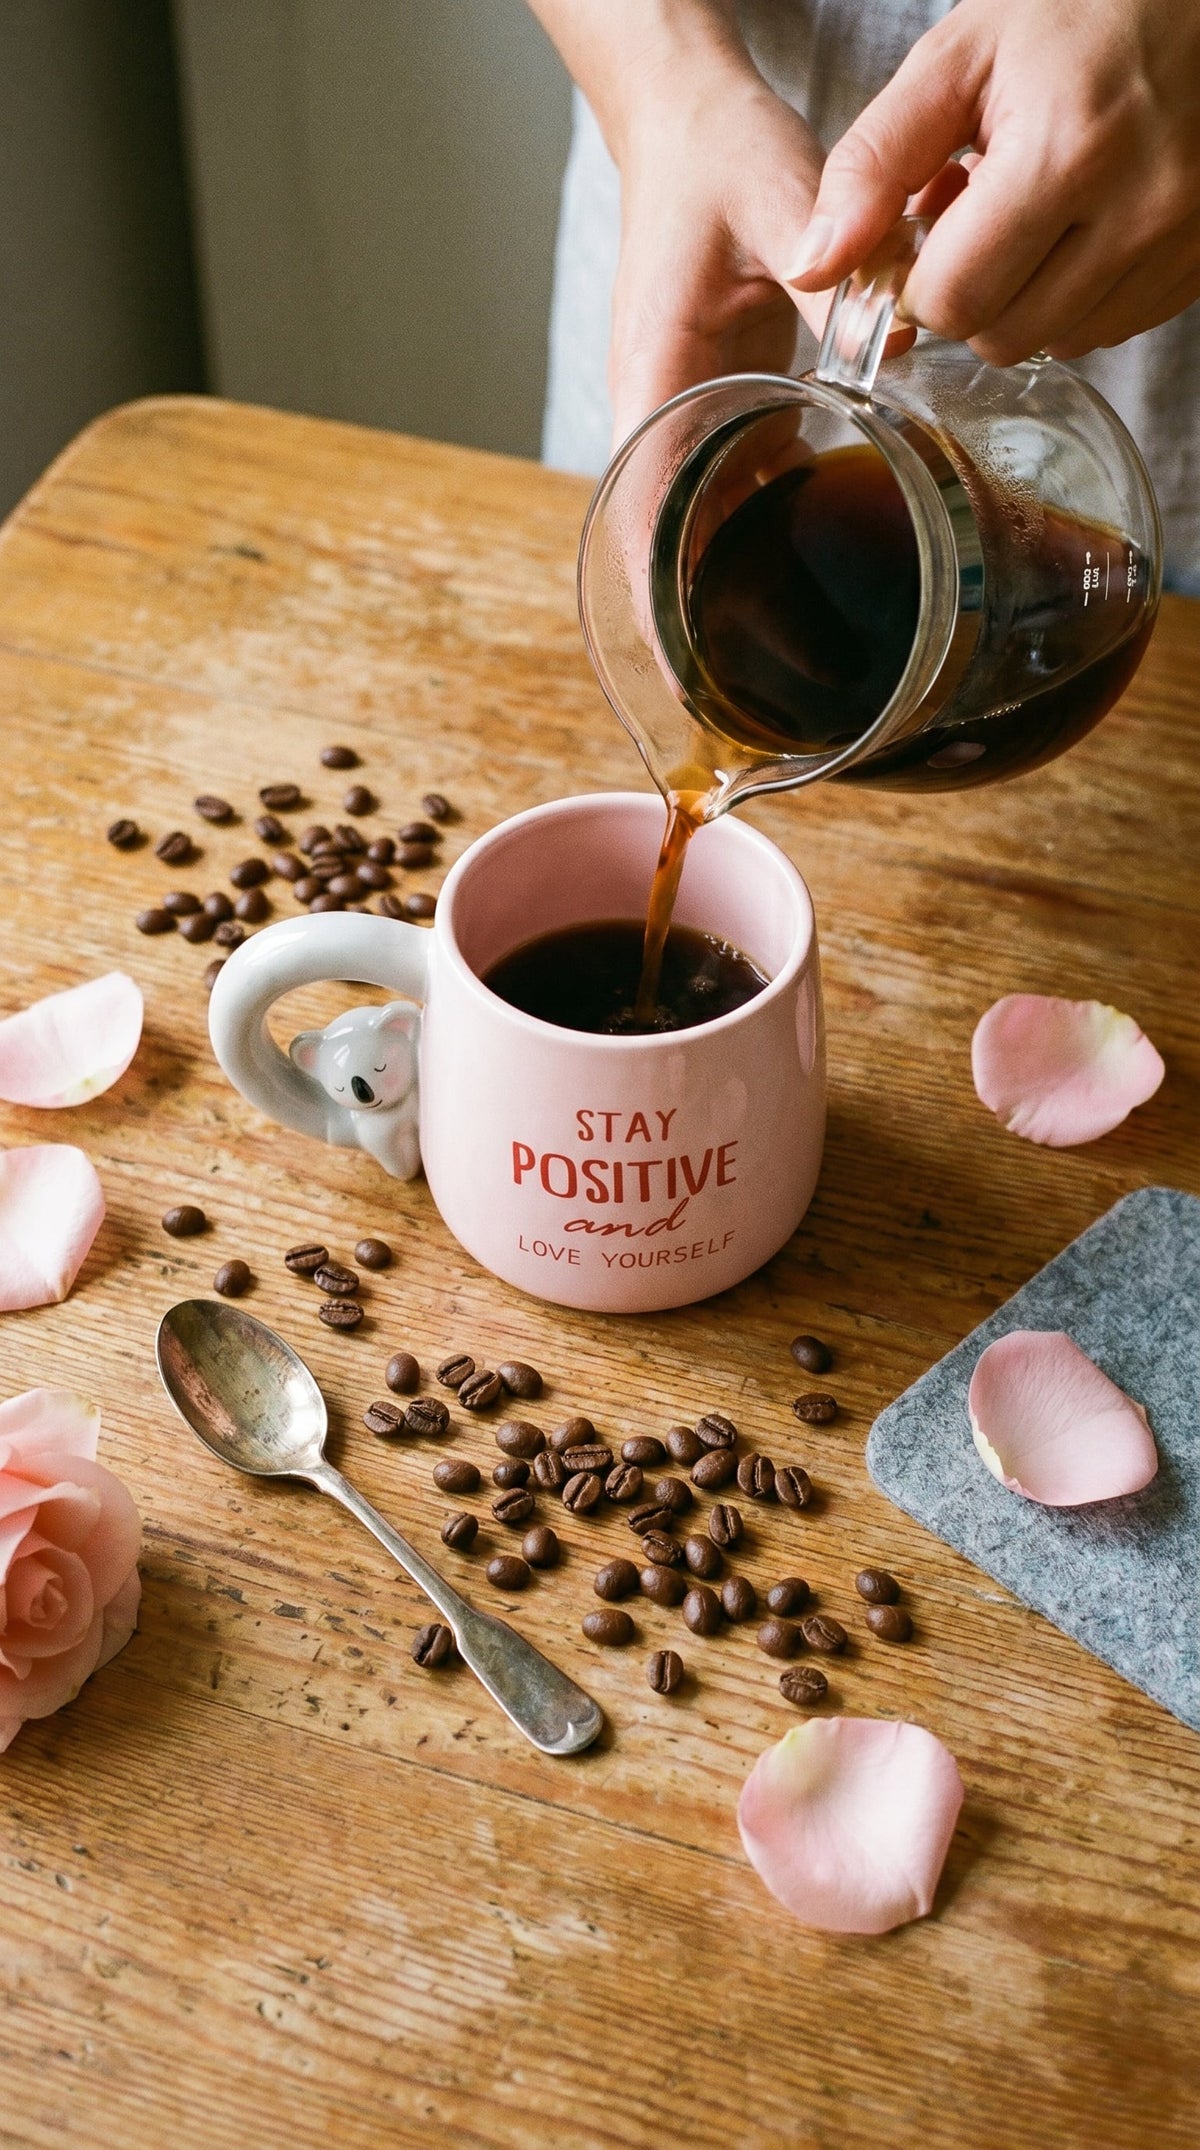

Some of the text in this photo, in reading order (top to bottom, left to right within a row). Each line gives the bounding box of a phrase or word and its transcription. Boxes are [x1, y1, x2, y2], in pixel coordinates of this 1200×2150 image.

[576, 1108, 677, 1143] STAY
[512, 1140, 738, 1204] POSITIVE
[563, 1197, 689, 1237] and
[518, 1230, 736, 1269] LOVE YOURSELF
